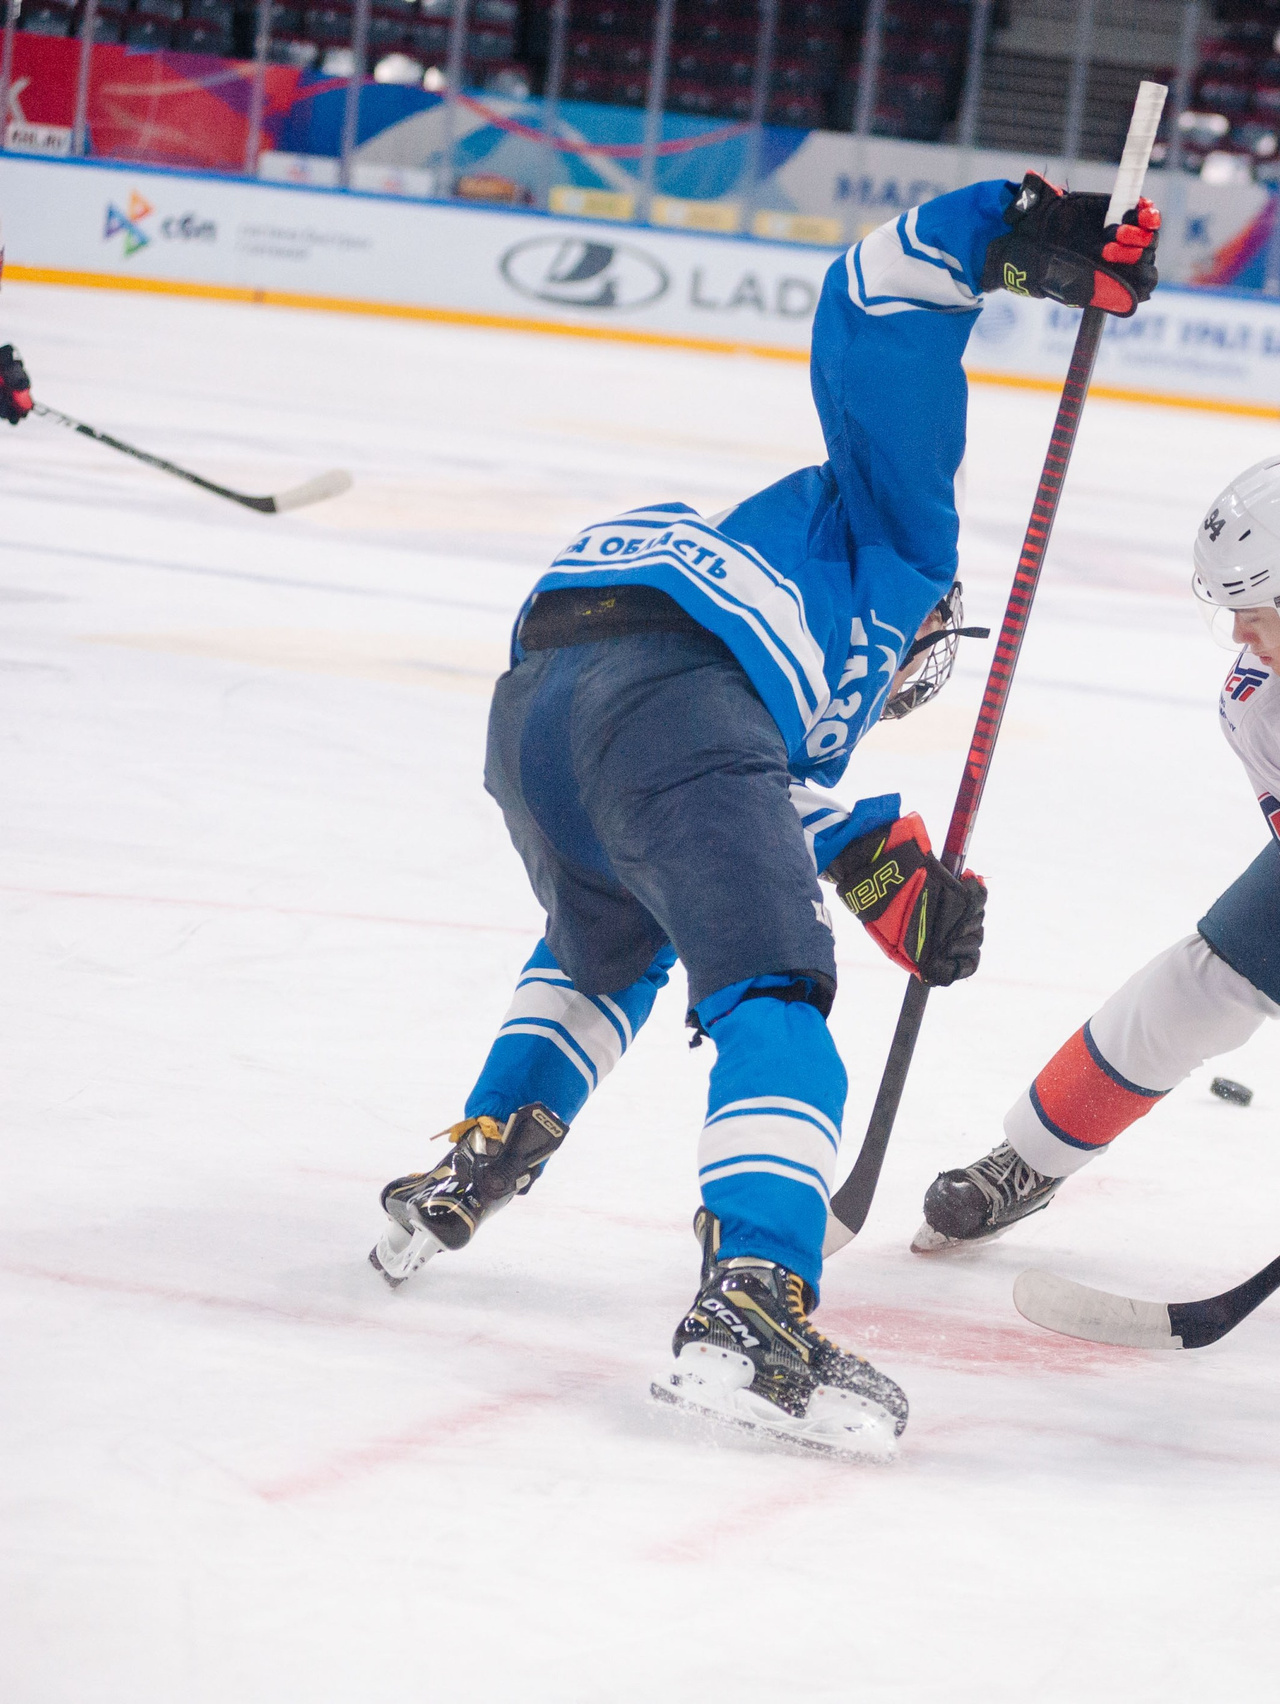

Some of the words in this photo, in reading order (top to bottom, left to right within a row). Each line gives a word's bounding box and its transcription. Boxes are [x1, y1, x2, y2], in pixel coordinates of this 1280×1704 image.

[690, 267, 818, 317] LAD
[1204, 508, 1226, 542] 94
[600, 531, 727, 579] ОБЛАСТЬ
[840, 859, 905, 915] UER
[534, 1111, 563, 1136] CCM
[701, 1298, 760, 1348] CCM
